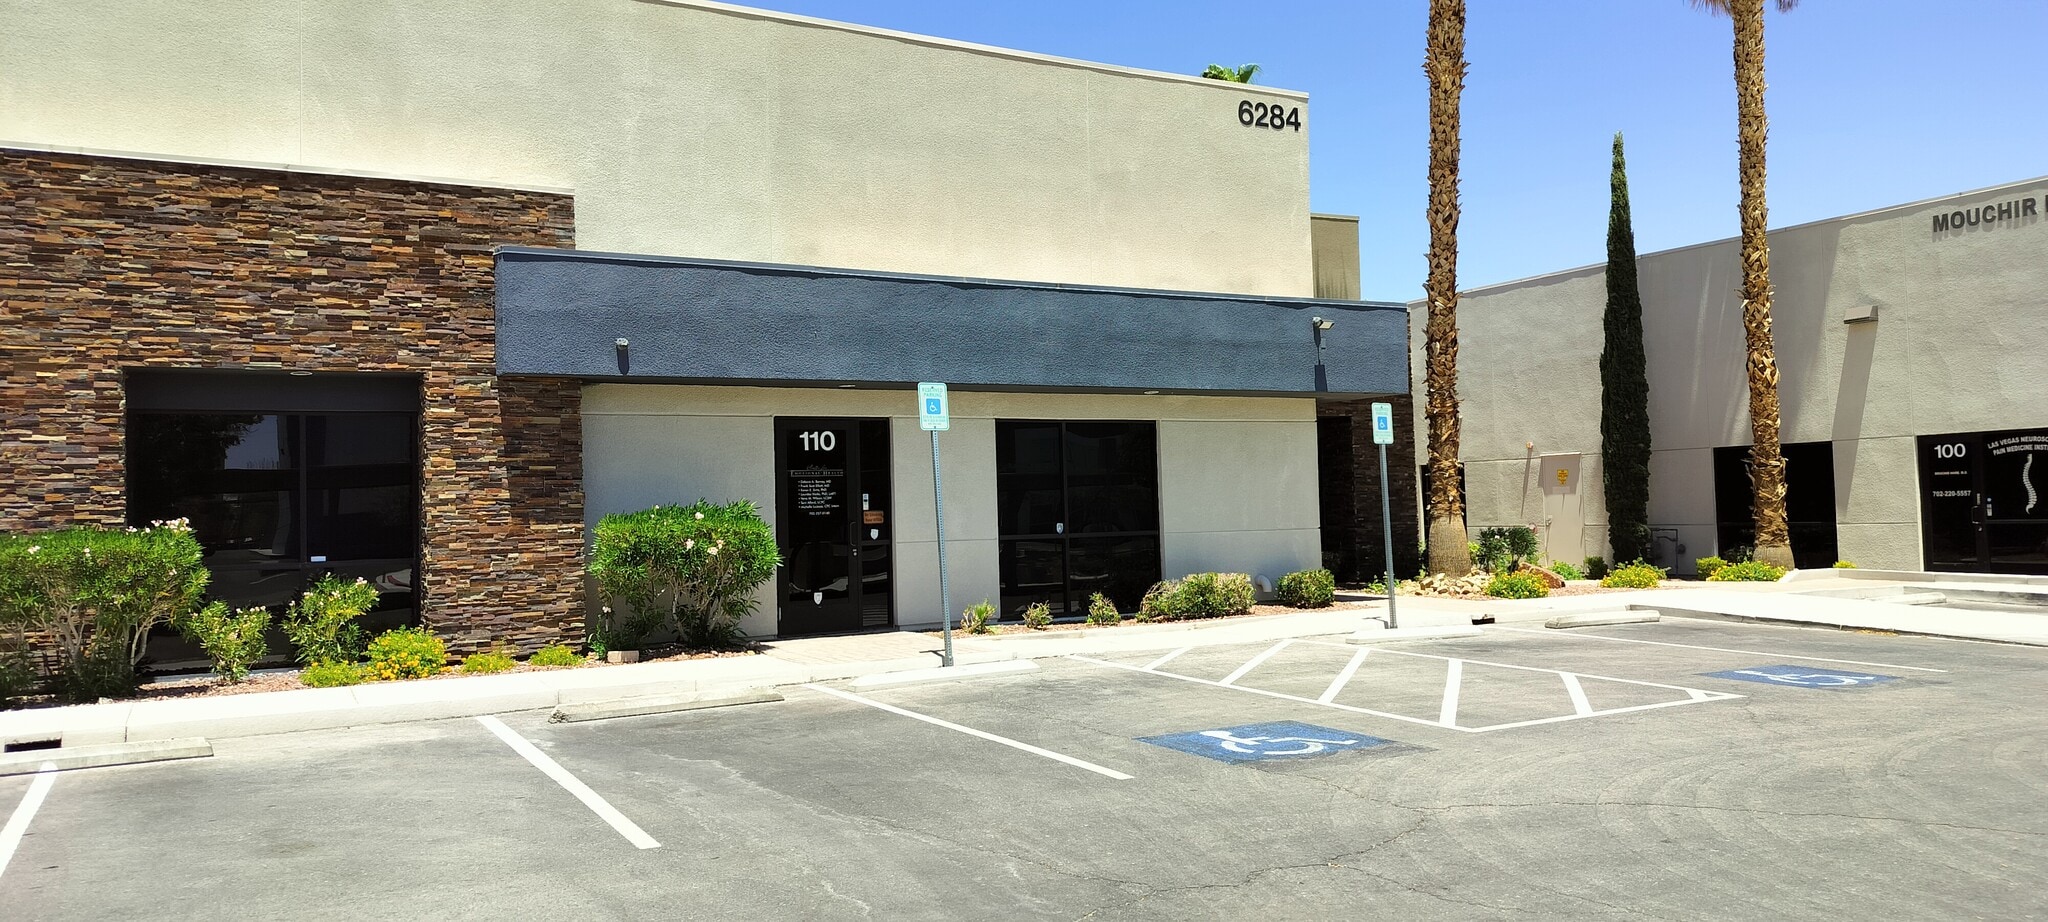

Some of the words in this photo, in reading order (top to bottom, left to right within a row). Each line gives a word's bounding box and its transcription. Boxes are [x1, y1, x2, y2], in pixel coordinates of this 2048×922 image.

[1238, 100, 1301, 131] 6284
[1932, 197, 2037, 233] MOUCHIR
[799, 430, 836, 451] 110
[1987, 441, 1999, 449] LAS
[1999, 436, 2020, 445] VEGAS
[1934, 443, 1966, 458] 100
[1993, 447, 2006, 456] PAIN
[2006, 444, 2034, 453] MEDICINE
